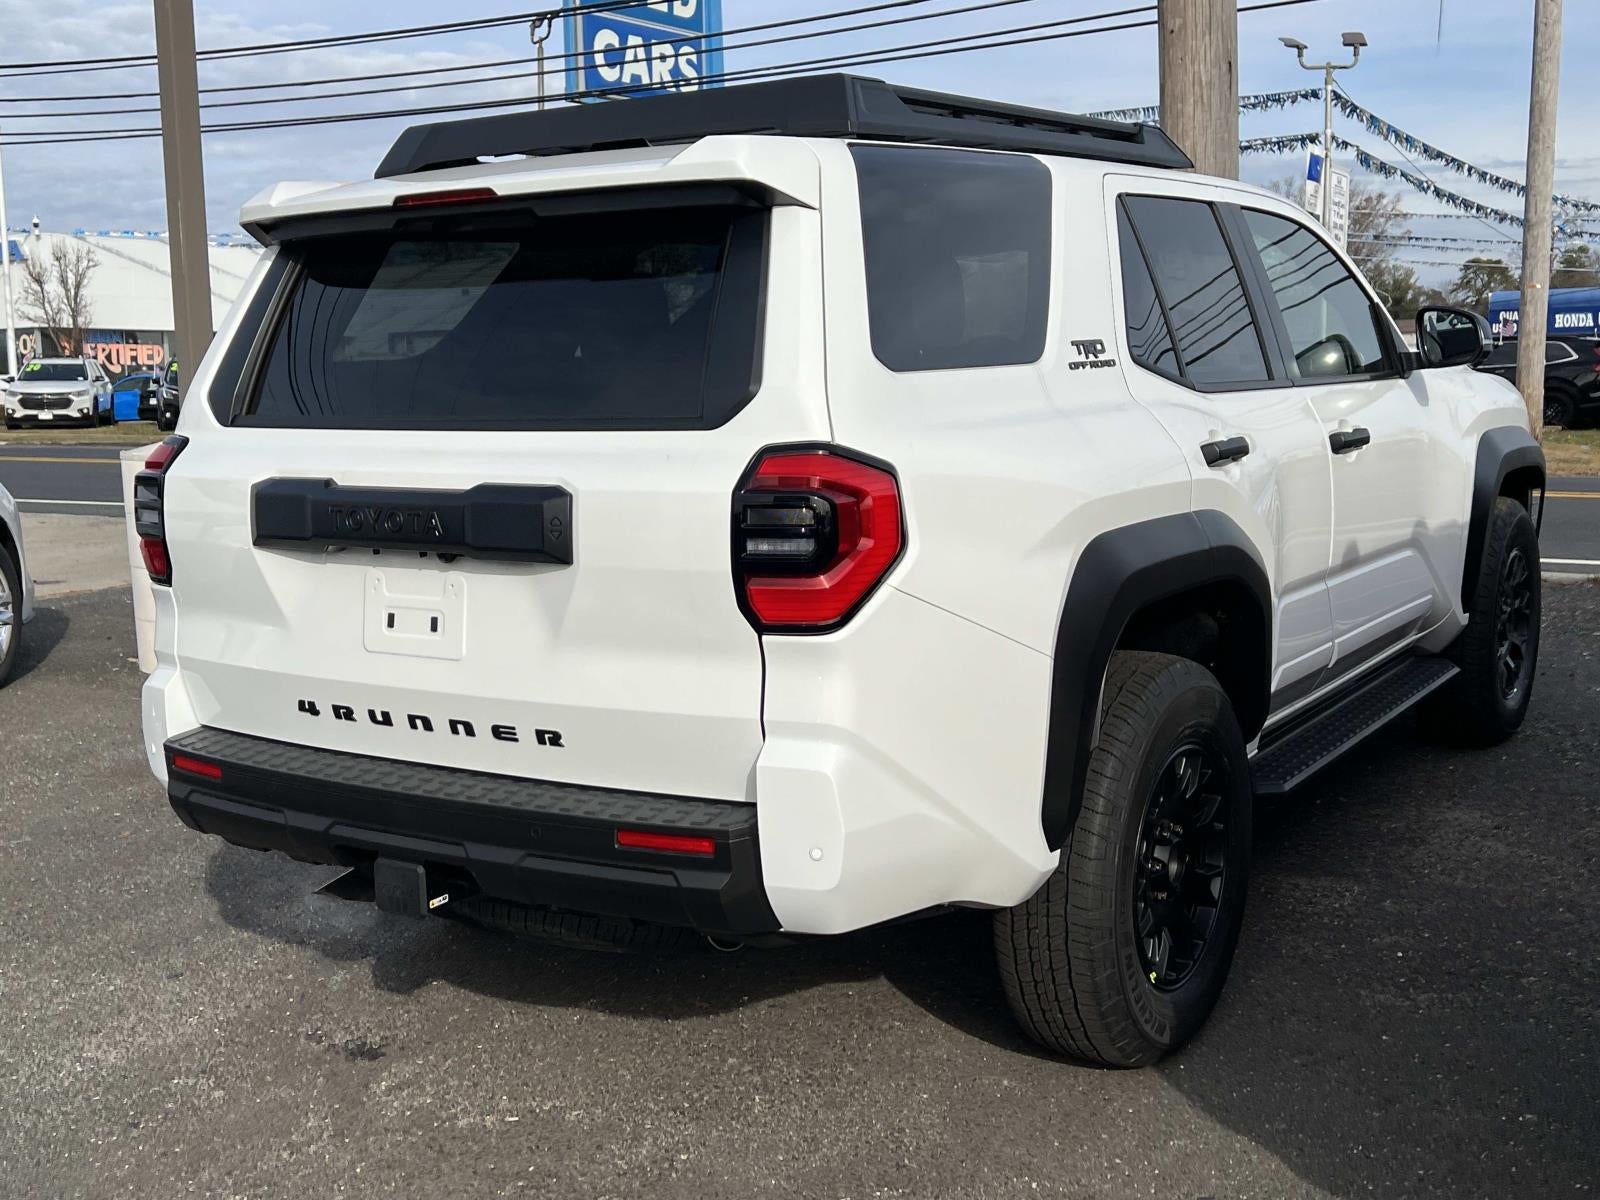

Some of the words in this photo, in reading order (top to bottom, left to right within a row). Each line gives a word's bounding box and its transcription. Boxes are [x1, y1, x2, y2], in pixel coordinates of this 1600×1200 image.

[593, 28, 699, 92] CARS
[1499, 311, 1519, 321] QUA
[1555, 312, 1594, 328] HONDA
[1071, 339, 1106, 359] TRD
[328, 504, 444, 537] TOYOTA
[297, 699, 566, 748] 4RUNNER
